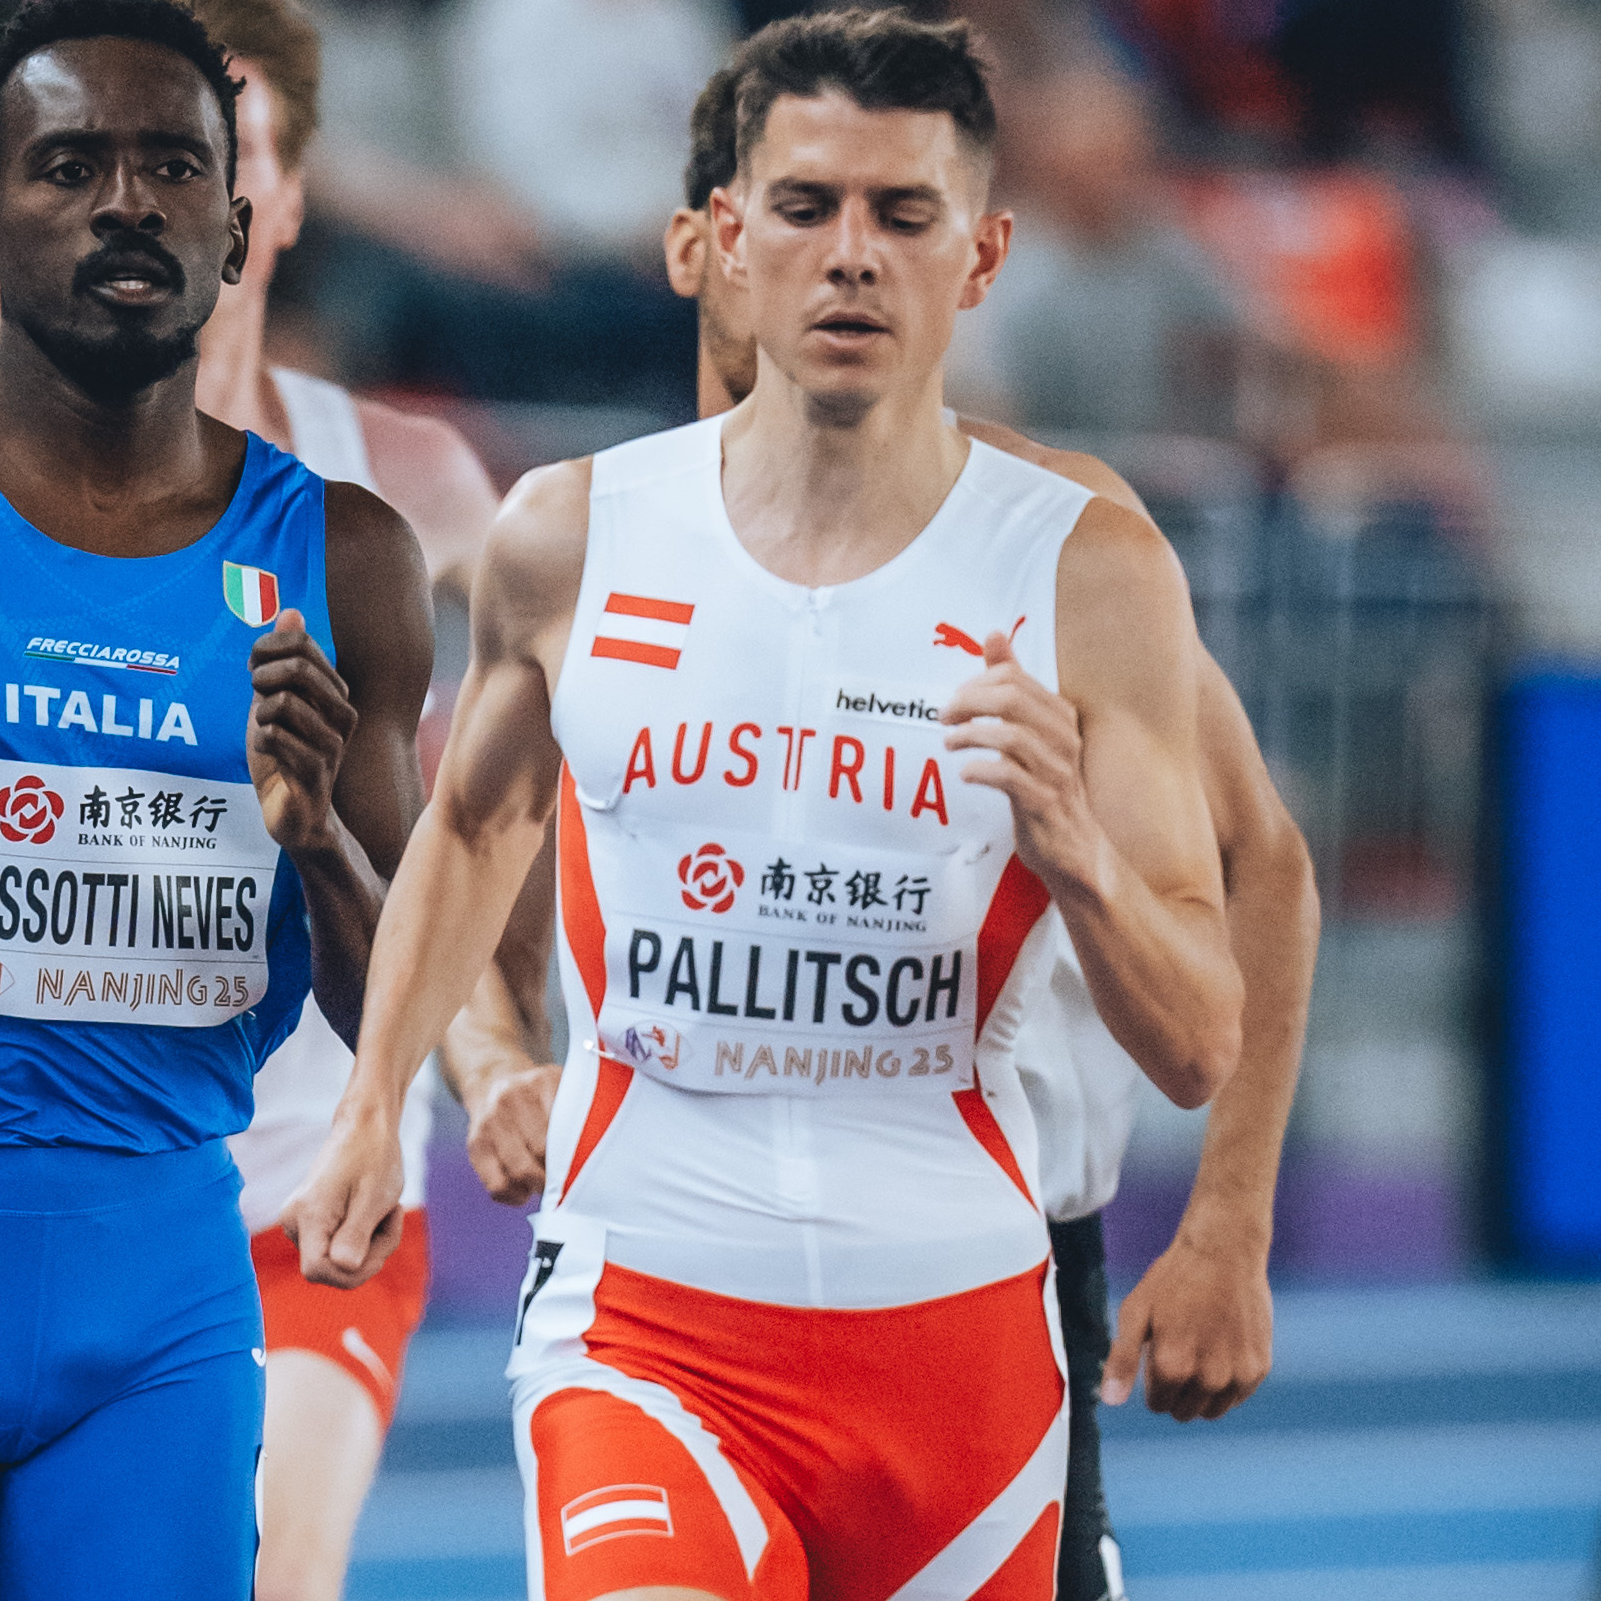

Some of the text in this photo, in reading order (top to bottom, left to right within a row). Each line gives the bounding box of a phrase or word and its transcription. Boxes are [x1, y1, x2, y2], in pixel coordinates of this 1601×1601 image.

[26, 637, 180, 669] FRECCIAROSSA
[6, 683, 198, 746] ITALIA
[622, 721, 949, 826] AUSTRIA
[78, 834, 217, 850] BANK OF NANJING
[152, 875, 256, 952] NEVES
[759, 904, 927, 933] BANK OF NANJING
[628, 928, 962, 1027] PALLITSCH
